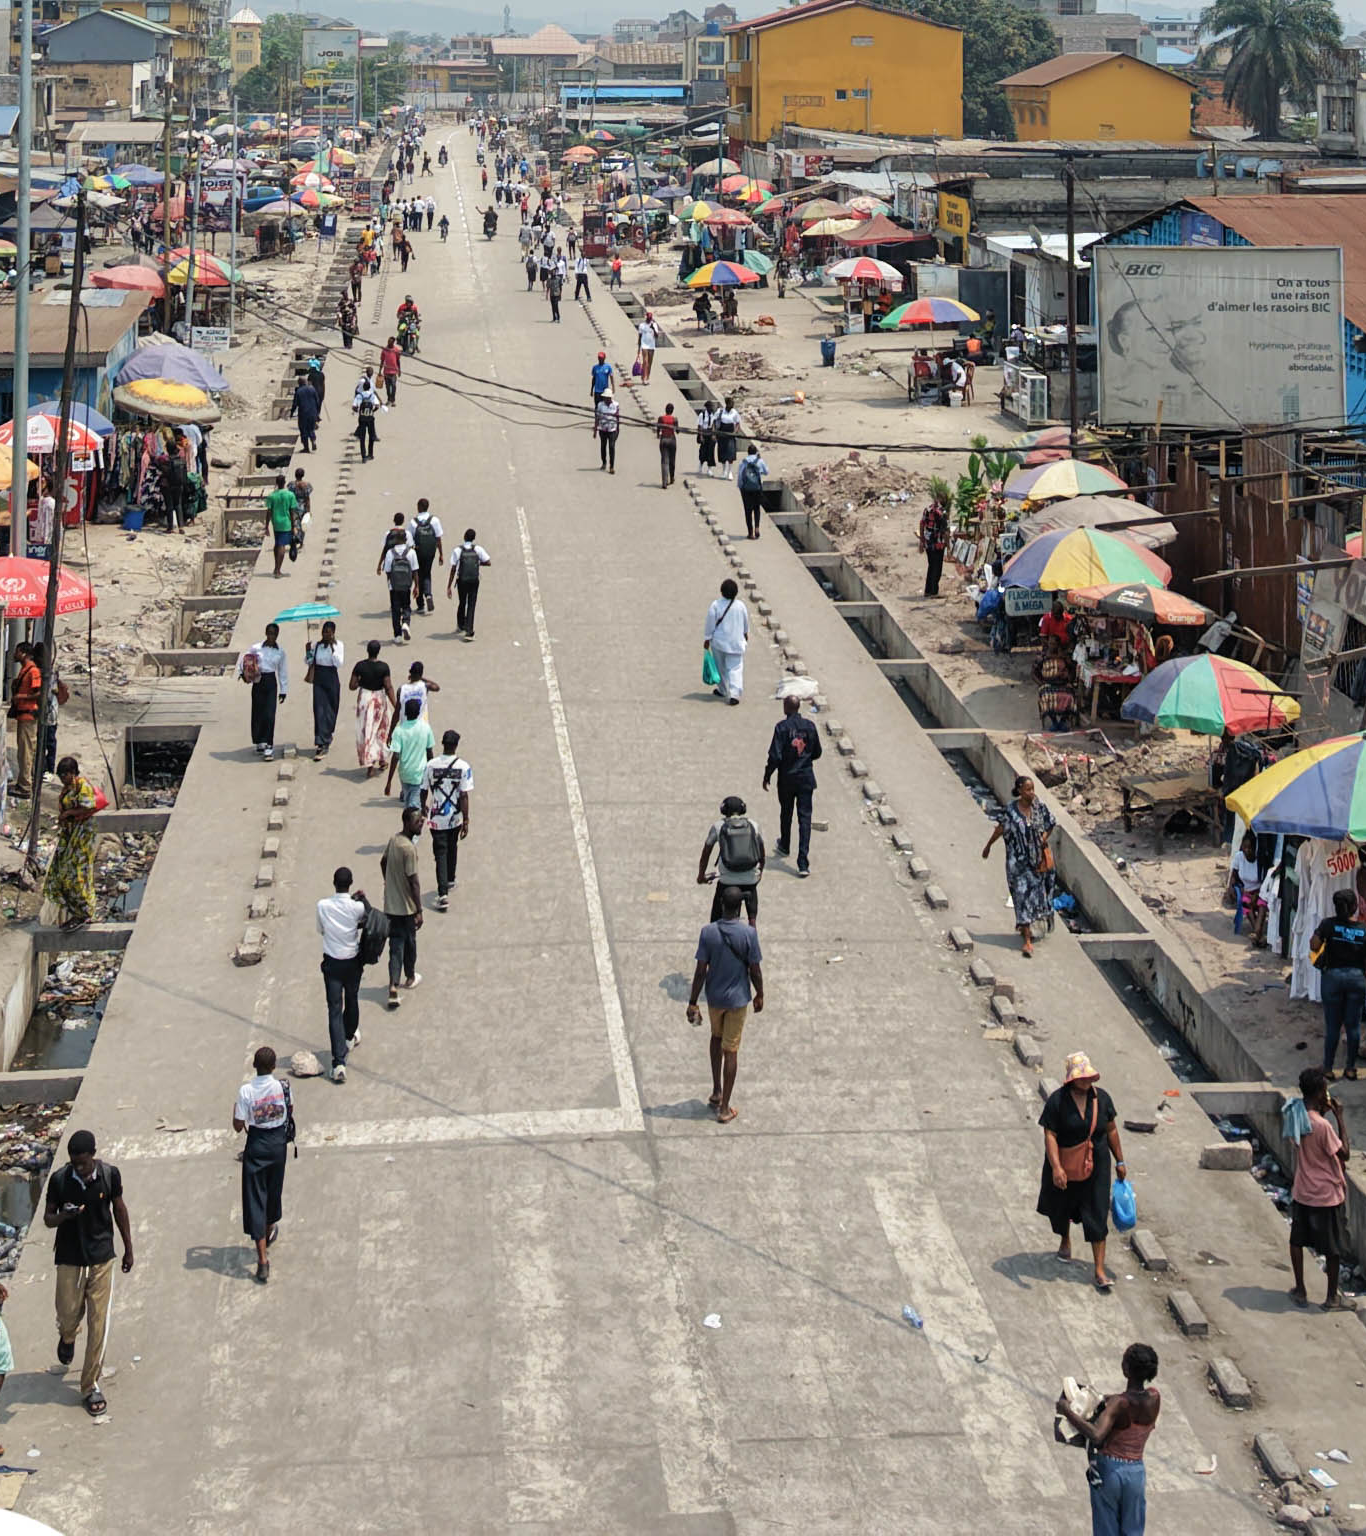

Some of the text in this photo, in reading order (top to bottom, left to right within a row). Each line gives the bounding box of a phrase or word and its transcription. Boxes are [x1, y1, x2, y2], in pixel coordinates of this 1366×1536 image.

[1277, 278, 1331, 288] On a tous
[1271, 290, 1330, 300] une raison
[1207, 302, 1331, 313] d'aimer les rasoirs BIC
[1297, 342, 1332, 352] pratique
[1293, 352, 1334, 361] efficace et
[1167, 612, 1197, 623] Orange
